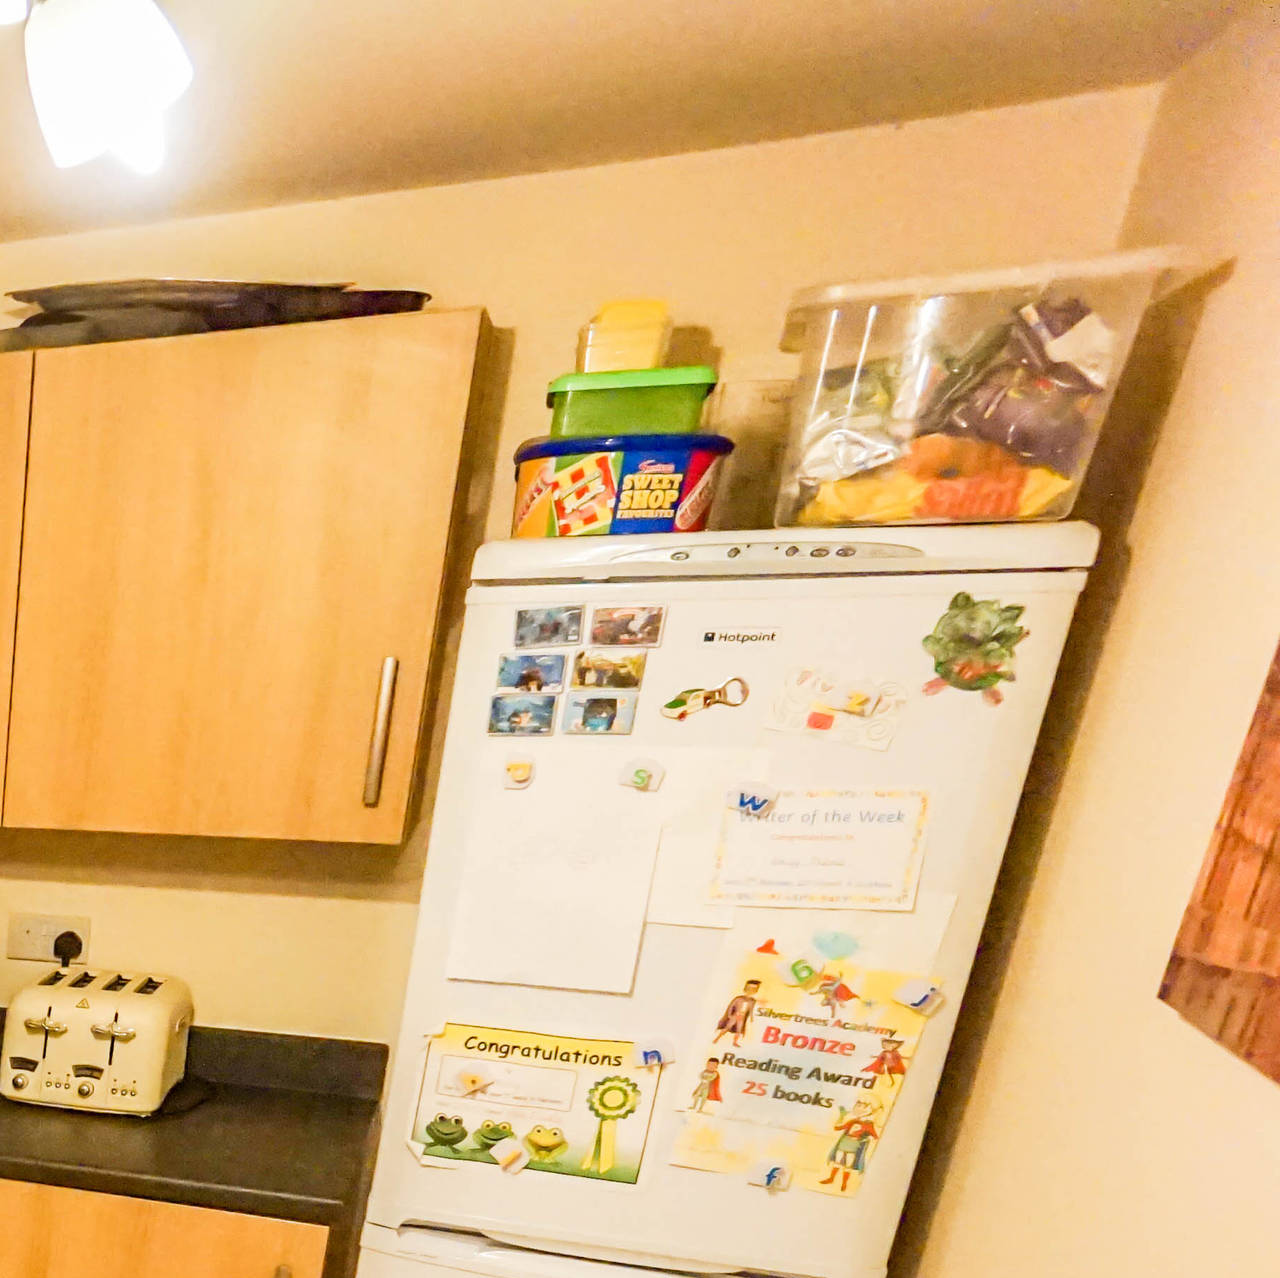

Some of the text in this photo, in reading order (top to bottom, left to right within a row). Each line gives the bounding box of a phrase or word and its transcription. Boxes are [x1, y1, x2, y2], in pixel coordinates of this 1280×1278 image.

[623, 473, 684, 490] SWEET
[620, 490, 679, 510] SHOP
[718, 631, 776, 643] Hotpoint
[801, 810, 819, 826] of
[825, 809, 852, 823] the
[859, 810, 906, 823] Week
[756, 1007, 897, 1038] Silvertrees Academy
[464, 1035, 623, 1067] Congratulations
[762, 1026, 856, 1056] Bronze
[721, 1052, 878, 1090] Reading Award
[741, 1081, 834, 1108] 25 books
